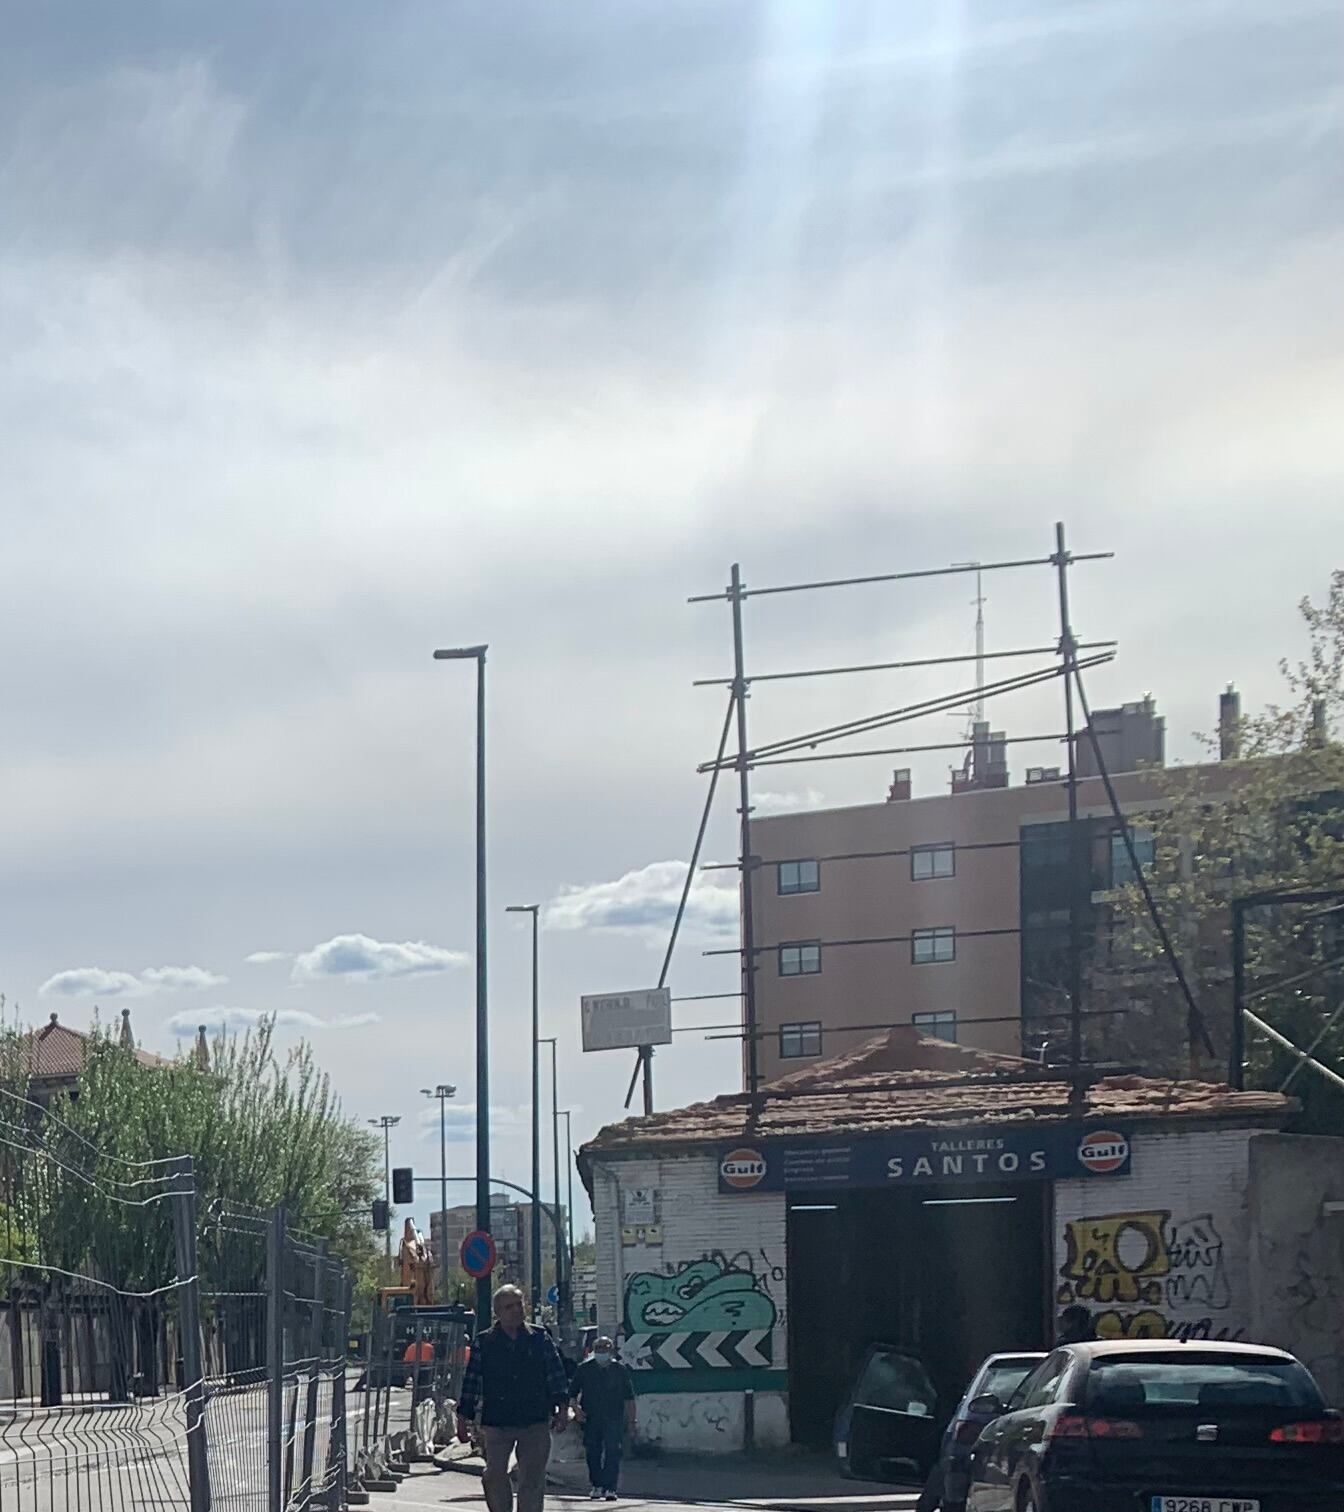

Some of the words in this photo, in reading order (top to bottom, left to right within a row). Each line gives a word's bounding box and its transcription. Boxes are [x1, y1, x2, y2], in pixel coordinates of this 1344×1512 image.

[931, 1138, 1005, 1152] TALLERES
[1082, 1144, 1129, 1158] Gulf
[723, 1163, 765, 1174] Gulf
[887, 1151, 1046, 1178] SANTOS
